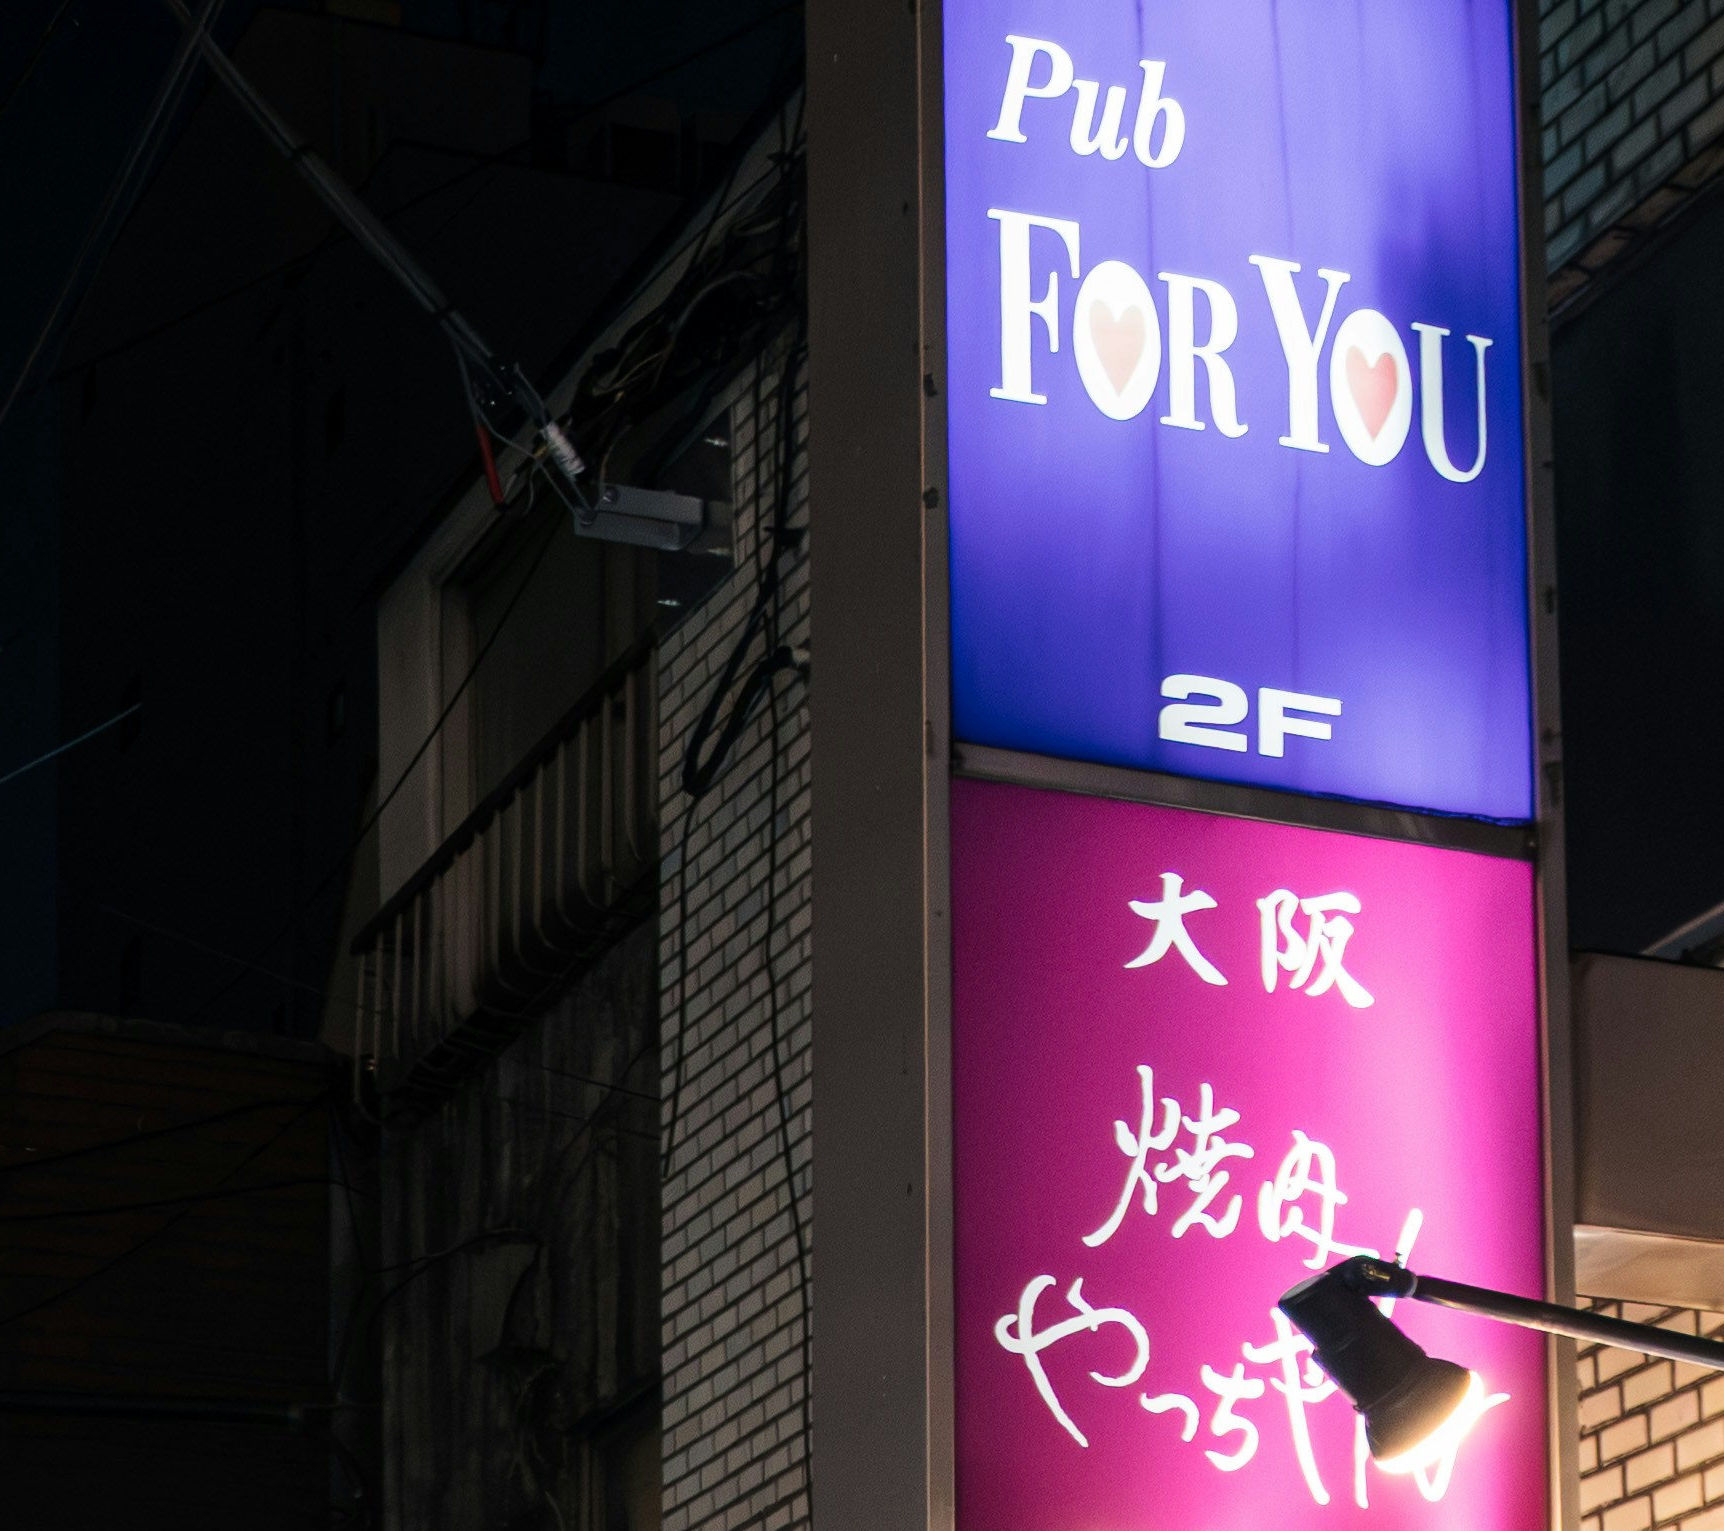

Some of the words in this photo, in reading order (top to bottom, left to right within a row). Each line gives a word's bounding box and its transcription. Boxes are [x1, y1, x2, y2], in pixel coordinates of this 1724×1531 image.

[987, 34, 1185, 169] Pub
[986, 208, 1249, 438] FOR
[1248, 254, 1492, 483] YOU
[1158, 674, 1342, 758] 2F
[1123, 871, 1375, 1009] 大阪
[1082, 1064, 1378, 1271] 焼肉
